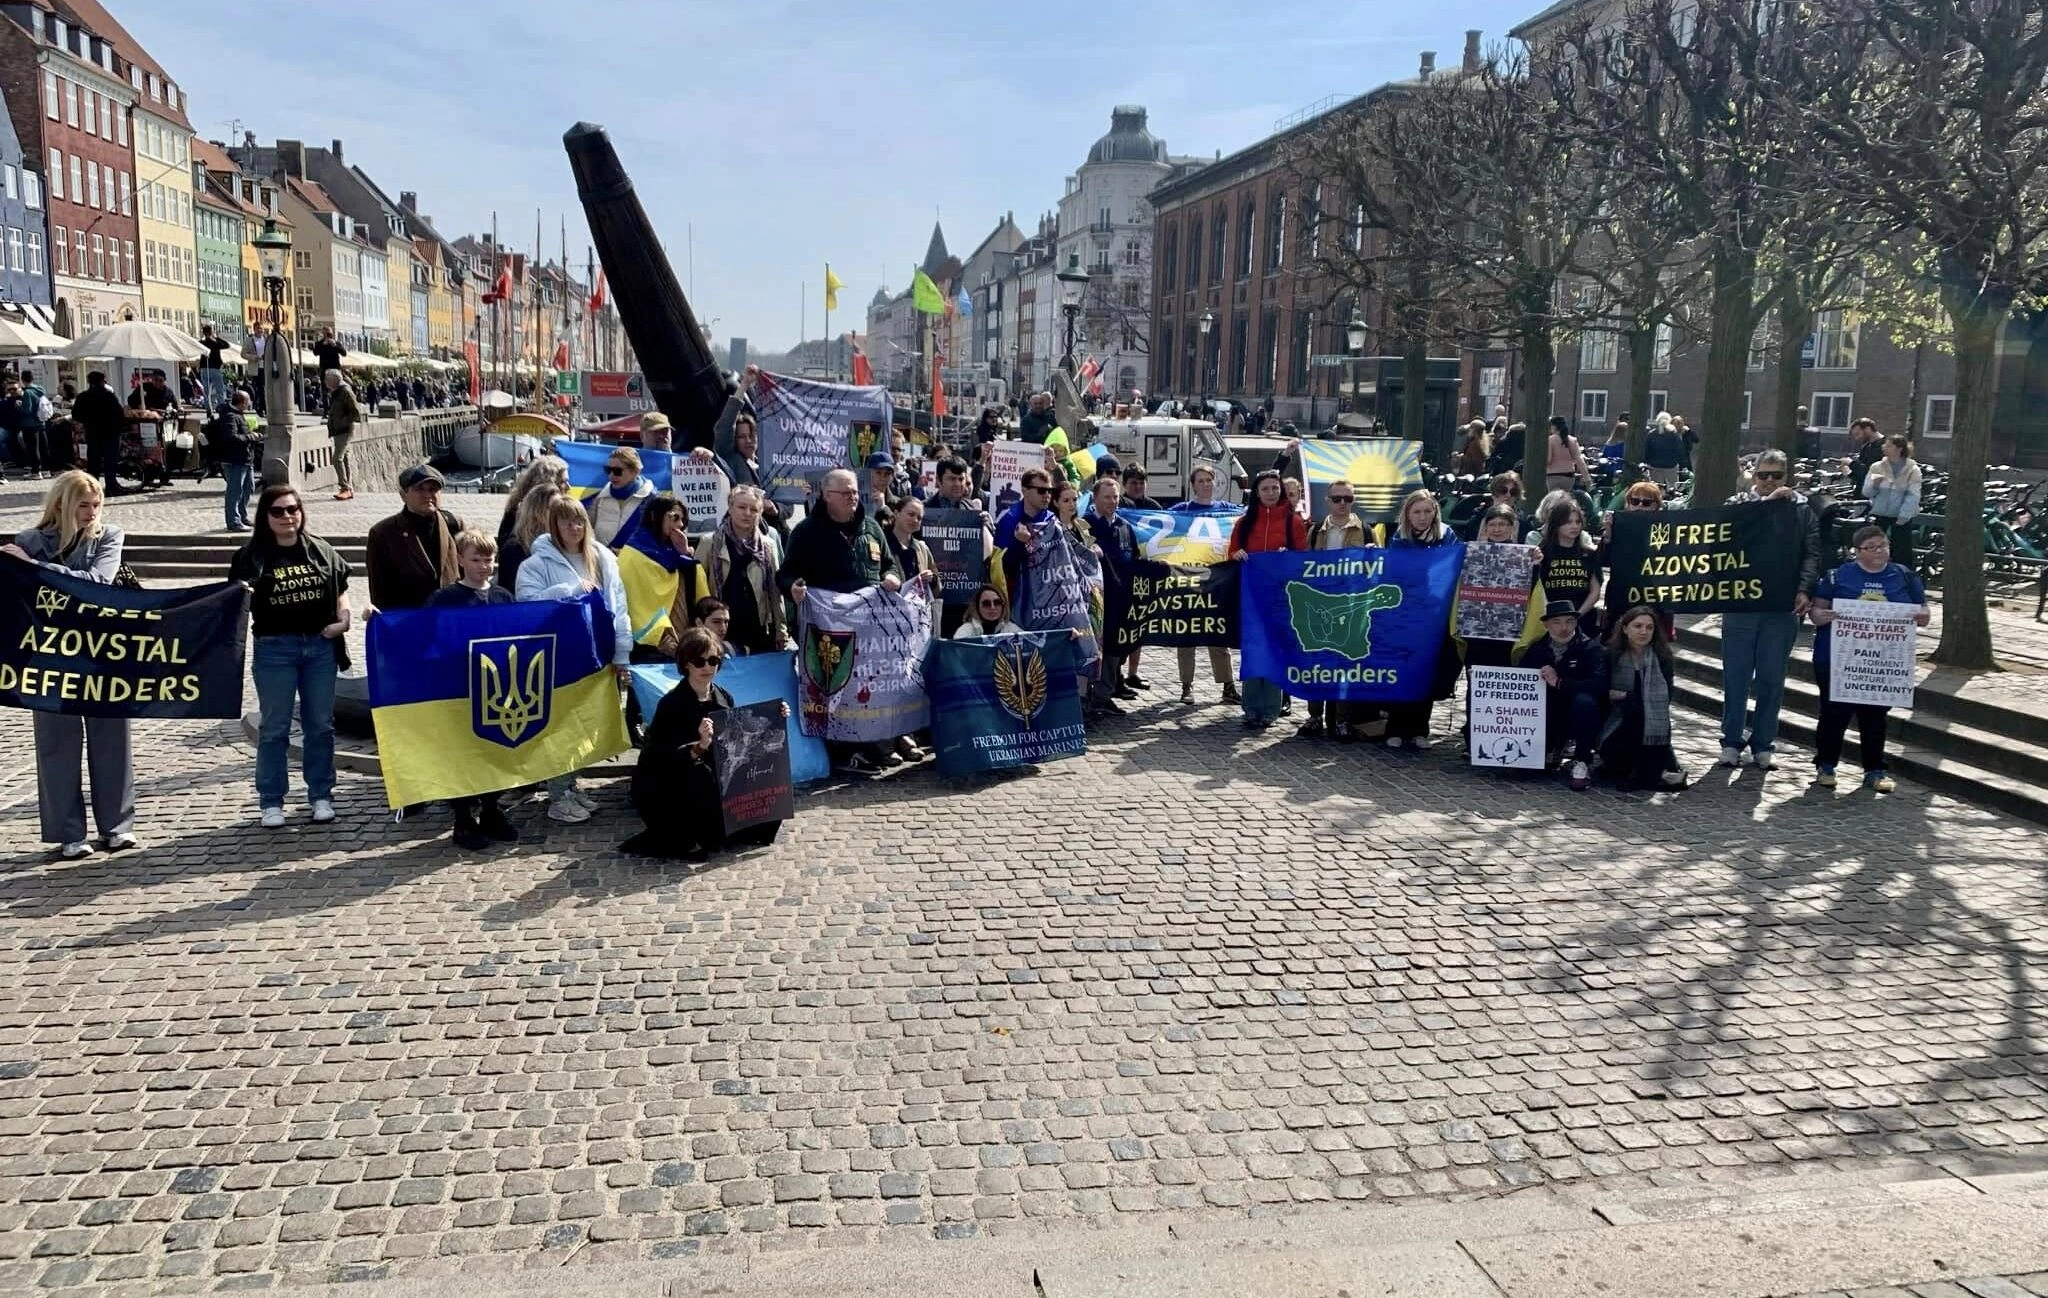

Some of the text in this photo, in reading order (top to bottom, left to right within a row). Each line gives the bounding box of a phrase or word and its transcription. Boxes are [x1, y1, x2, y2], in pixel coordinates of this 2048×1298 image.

[780, 418, 848, 438] UKRAINIAN
[794, 437, 845, 458] WARS in
[772, 455, 812, 466] RUSSIAN
[994, 456, 1017, 464] THREE
[696, 467, 706, 475] BE
[993, 464, 1017, 472] YEARS
[681, 482, 718, 491] WE ARE
[685, 494, 713, 503] THEIR
[687, 506, 717, 515] OICES
[922, 526, 981, 540] RUSSIAN CAPTIVITY
[1676, 523, 1732, 545] FREE
[943, 540, 961, 551] KILLS
[1303, 556, 1384, 578] Zmiinyi
[1641, 550, 1750, 576] AZOVSTAL
[287, 564, 315, 576] FREE
[937, 571, 969, 581] ENEVA
[1548, 568, 1588, 578] AZOVSTAL
[273, 576, 324, 592] AZOVSTA
[942, 581, 981, 590] VENTION
[1155, 575, 1201, 593] FREE
[1545, 579, 1586, 588] DEFENDE
[1628, 578, 1764, 603] DEFENDERS
[269, 589, 323, 605] DEFENDE
[1127, 593, 1218, 620] AZOVSTAL
[1118, 616, 1226, 644] DEFENDERS
[1837, 621, 1906, 634] THREE YEARS
[1836, 630, 1908, 642] OF CAPTIVITY
[19, 625, 187, 664] AZOVSTAL
[1854, 648, 1881, 658] PAIN
[1863, 658, 1905, 668] TORMENT
[1287, 663, 1398, 684] Defenders
[1475, 670, 1540, 682] IMPRISONED
[1843, 665, 1909, 677] HUMILIATION
[0, 663, 200, 702] DEFENDERS
[1847, 674, 1886, 684] TORTURE
[1478, 680, 1536, 692] DEFENDERS
[1844, 682, 1913, 694] UNCERTAINTY
[1475, 690, 1539, 701] OF FREEDOM
[1485, 705, 1493, 714] A
[1495, 706, 1540, 717] SHAME
[1495, 716, 1513, 725] ON
[1473, 724, 1537, 736] HUMANITY
[972, 724, 1086, 749] FREEDOM FOR CAPTUR
[988, 737, 1087, 762] UKRAINIAN MARINES
